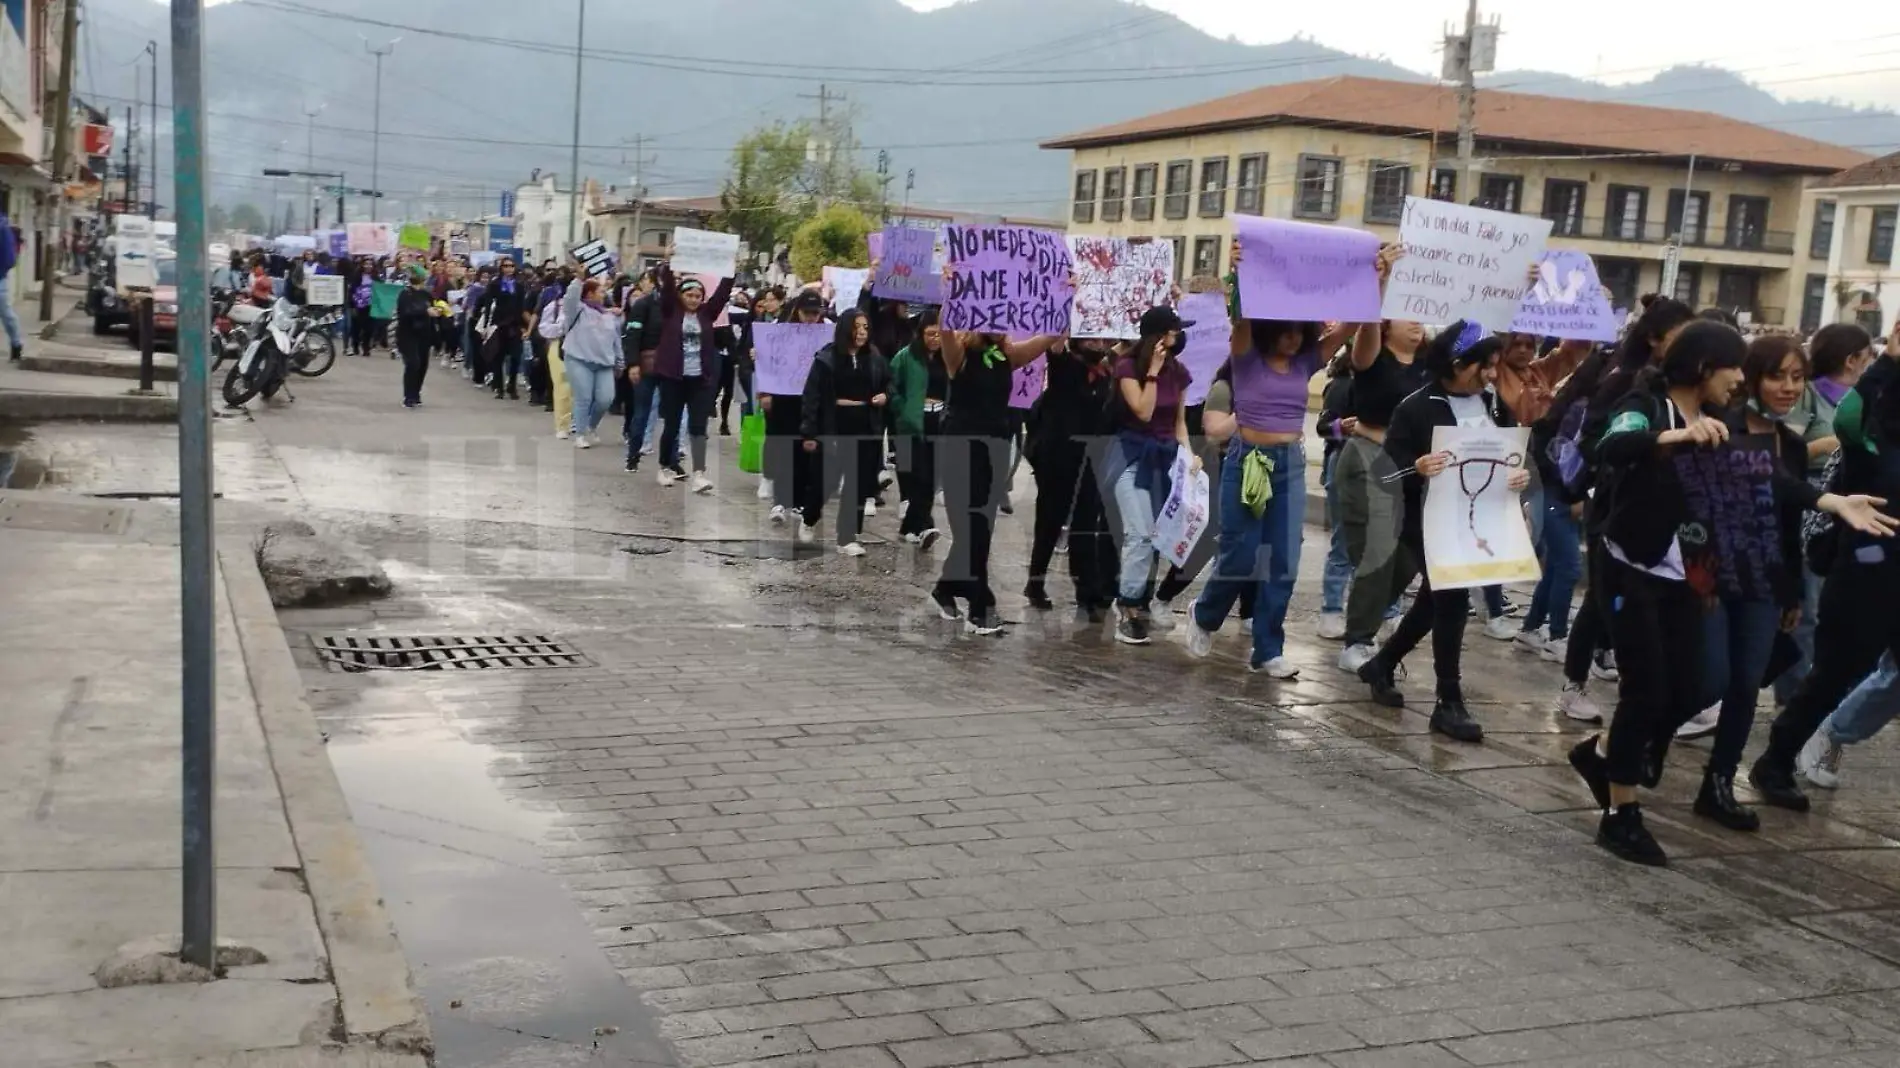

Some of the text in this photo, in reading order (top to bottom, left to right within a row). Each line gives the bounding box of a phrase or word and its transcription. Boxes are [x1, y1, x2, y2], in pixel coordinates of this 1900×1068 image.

[948, 226, 979, 262] NO
[1501, 232, 1529, 253] yo
[1457, 252, 1474, 267] en
[1478, 252, 1499, 272] las
[950, 270, 1008, 300] DAME
[1018, 271, 1052, 301] MIS
[969, 297, 1073, 332] DERECHOS
[1398, 293, 1449, 319] TODO
